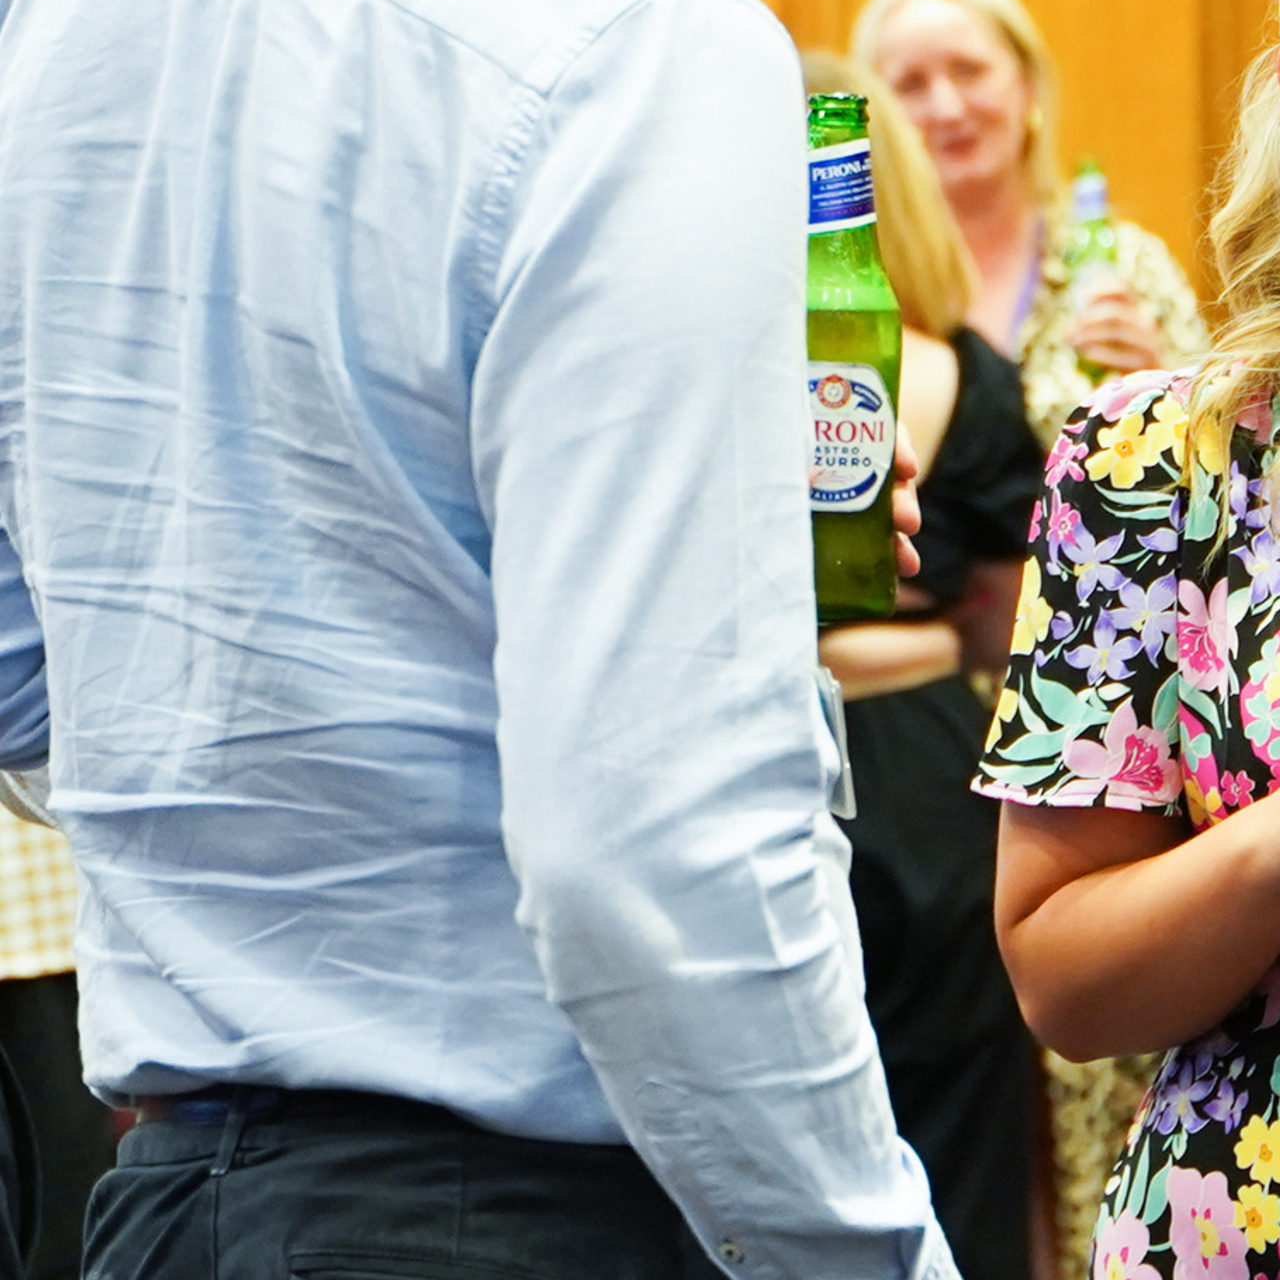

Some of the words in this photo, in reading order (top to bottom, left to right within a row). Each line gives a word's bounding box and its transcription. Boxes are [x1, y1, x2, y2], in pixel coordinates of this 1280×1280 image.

[812, 160, 862, 181] PERONI
[814, 420, 884, 443] RONI
[814, 446, 860, 455] ASTRO
[813, 456, 872, 468] ZURRO
[813, 489, 857, 500] ALIANA
